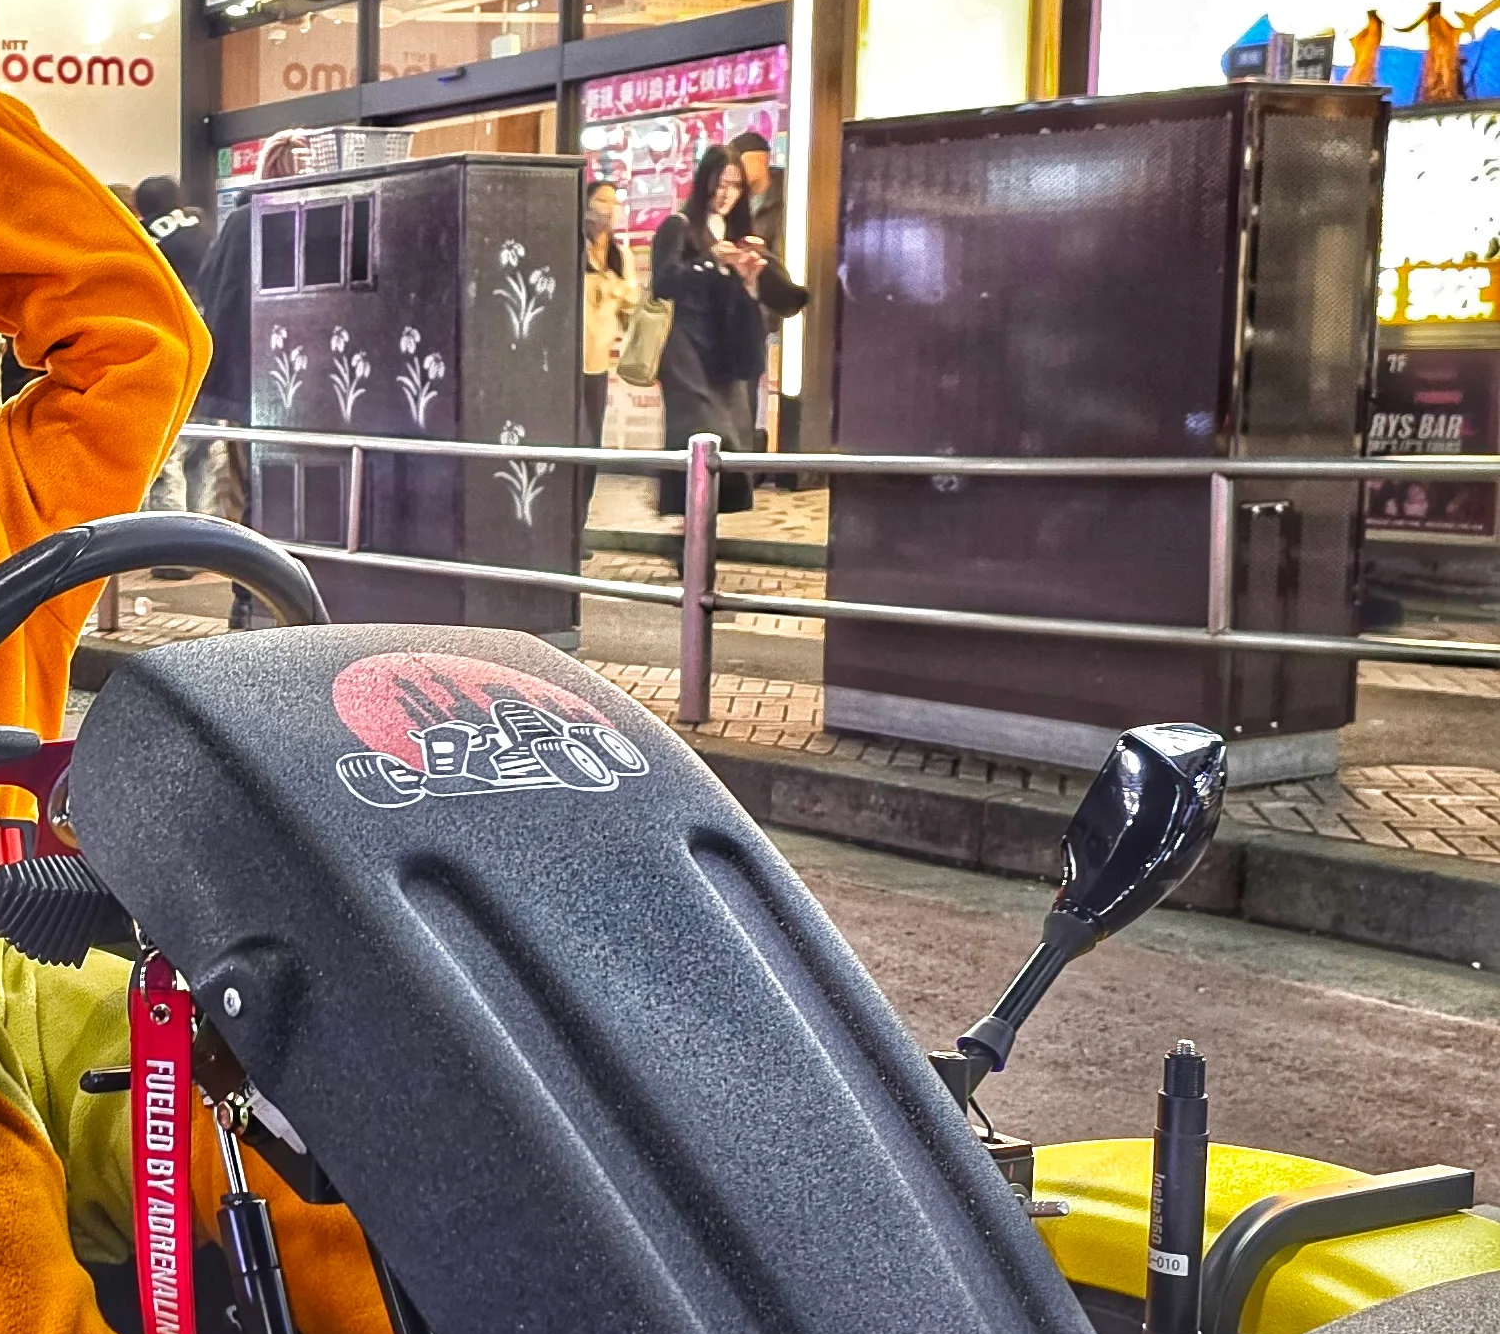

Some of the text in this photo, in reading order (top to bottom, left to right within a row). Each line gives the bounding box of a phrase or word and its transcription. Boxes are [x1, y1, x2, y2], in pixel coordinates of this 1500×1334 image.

[1, 39, 29, 51] NTT
[1417, 412, 1464, 440] BAR
[145, 1060, 175, 1152] FUELED
[146, 1159, 175, 1196] BY
[1151, 1172, 1166, 1245] Insta360
